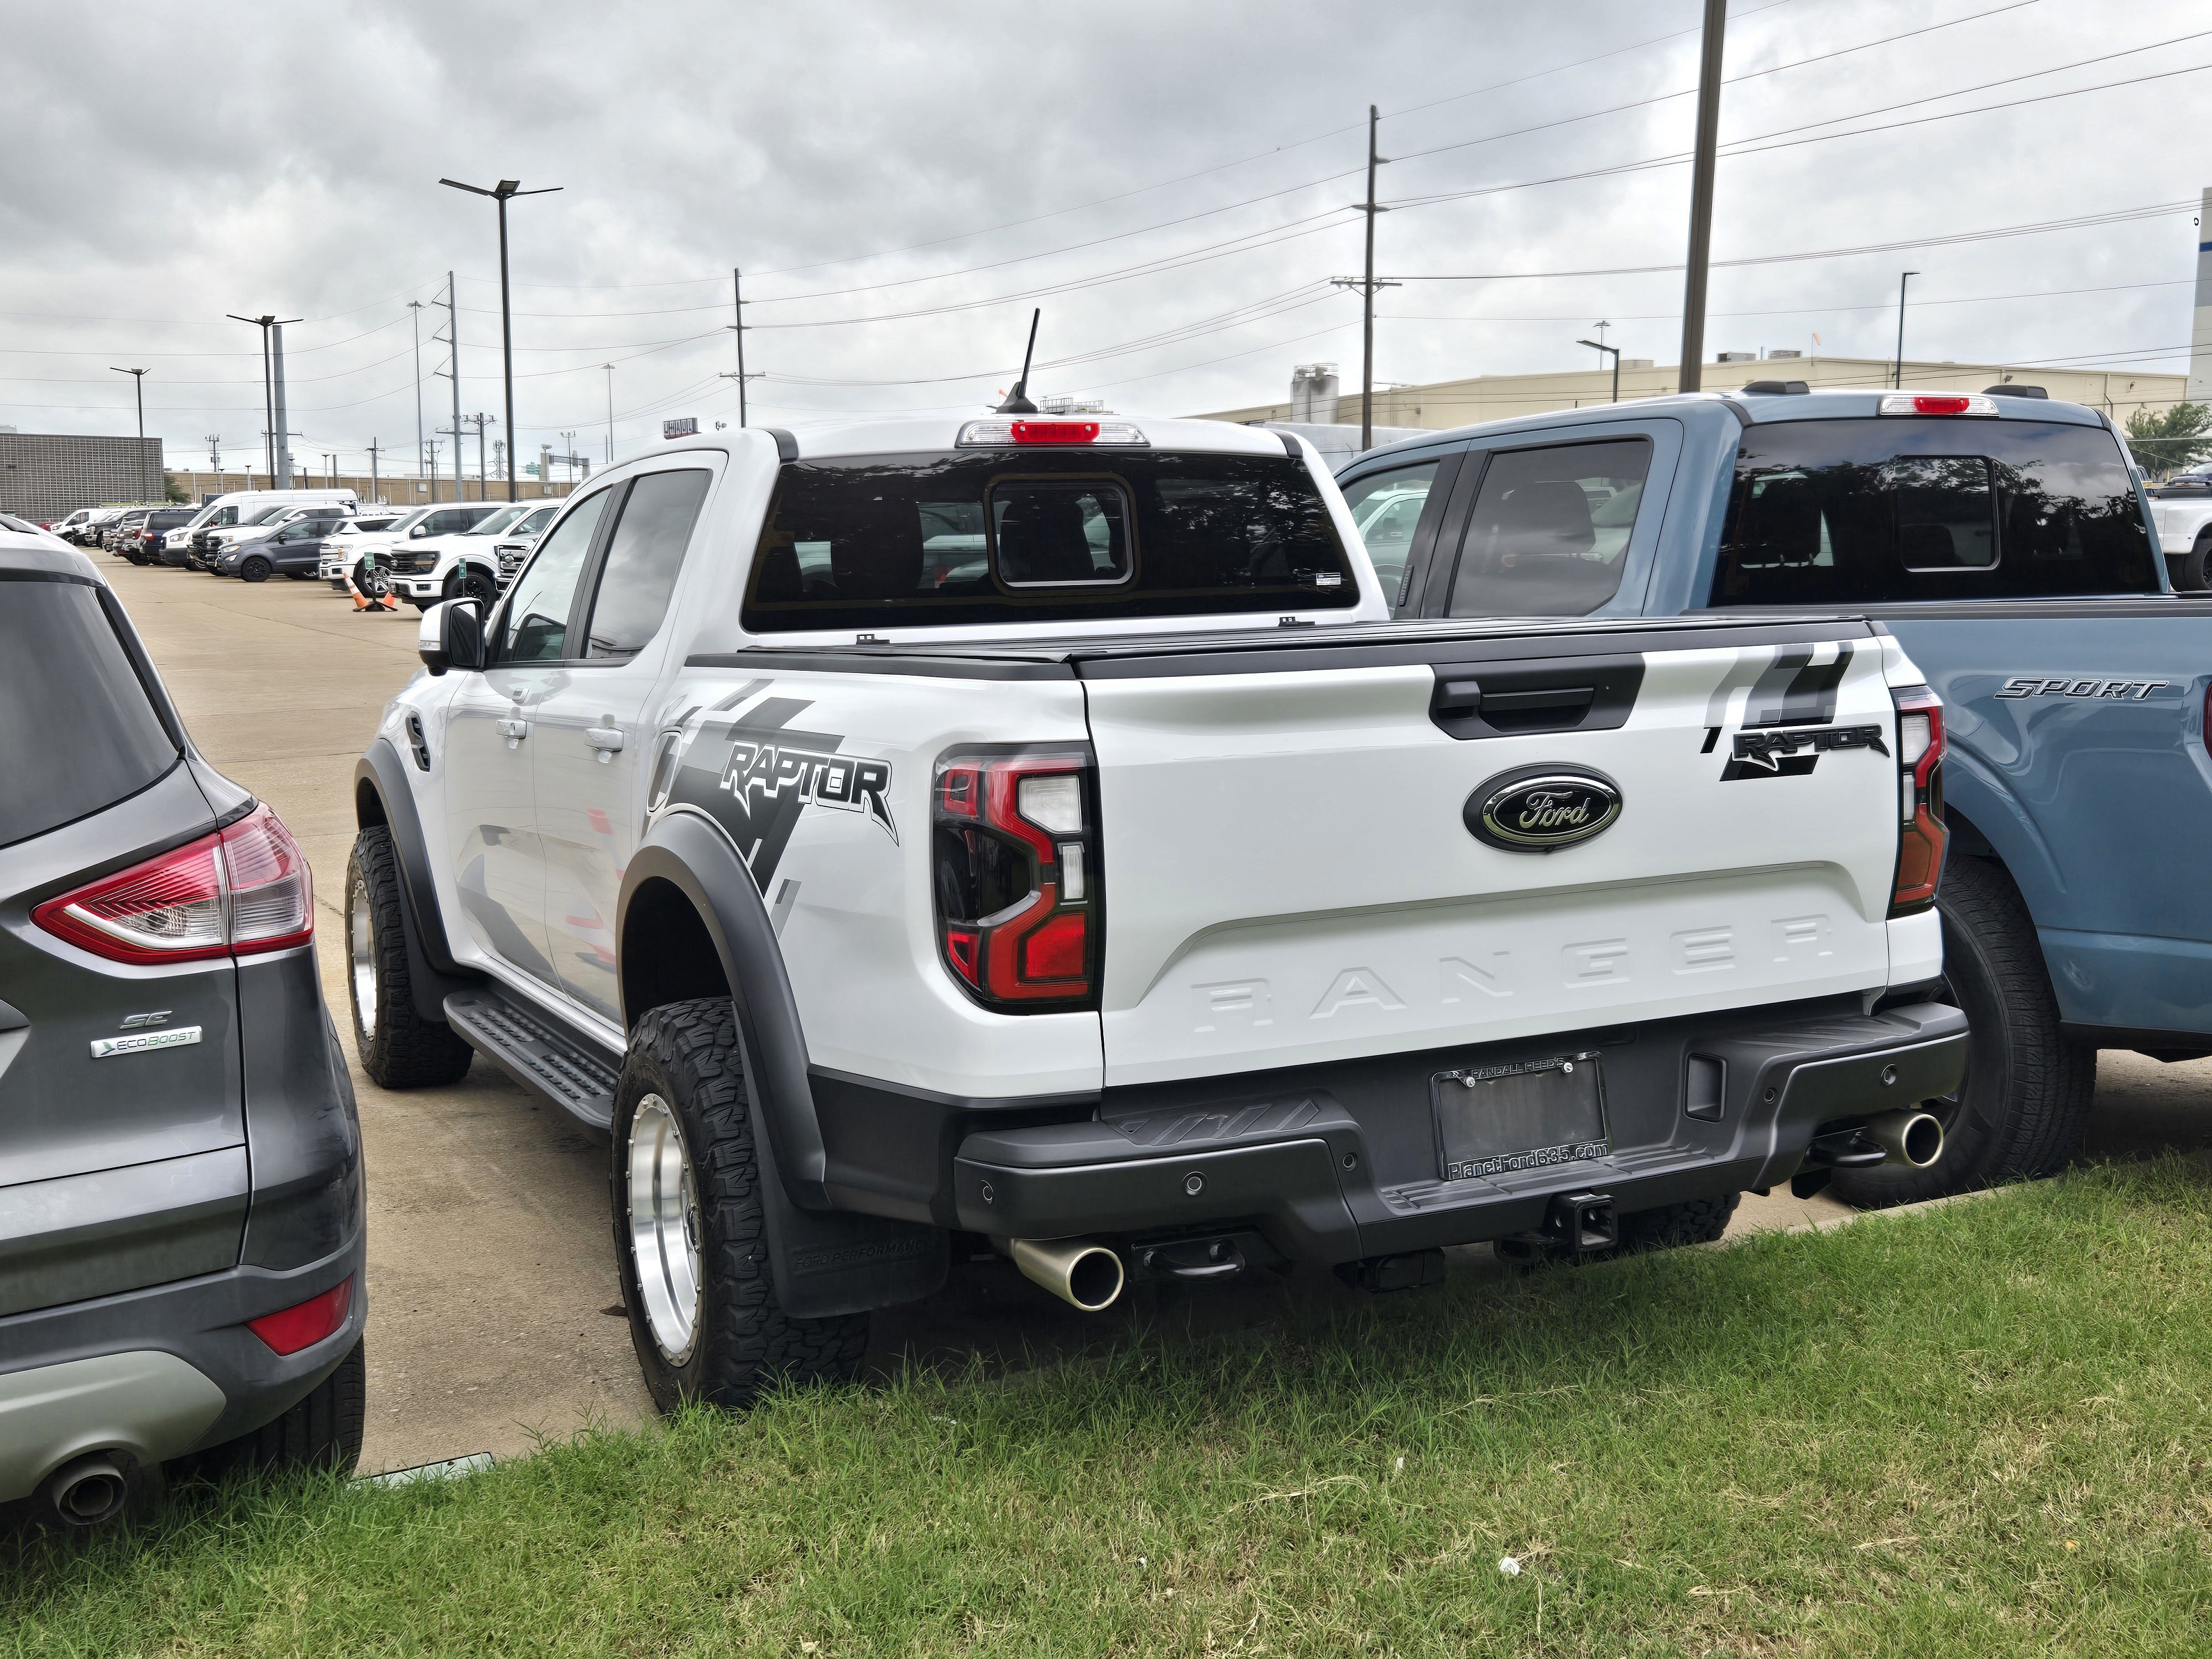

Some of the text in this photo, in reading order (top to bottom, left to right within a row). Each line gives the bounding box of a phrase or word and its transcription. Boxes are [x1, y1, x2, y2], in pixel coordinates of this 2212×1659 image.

[1993, 676, 2170, 701] SPORT
[1733, 723, 1890, 768] RAPTOR
[719, 739, 900, 847] RAPTOR
[1519, 791, 1591, 829] Ford
[1190, 913, 1835, 1033] RANGER
[119, 1010, 173, 1030] SE
[117, 1031, 196, 1050] ECOBOOST
[1471, 1057, 1564, 1078] RANDALL REED'S
[1448, 1143, 1608, 1180] PlanetFord635.com
[795, 1254, 829, 1268] FORD
